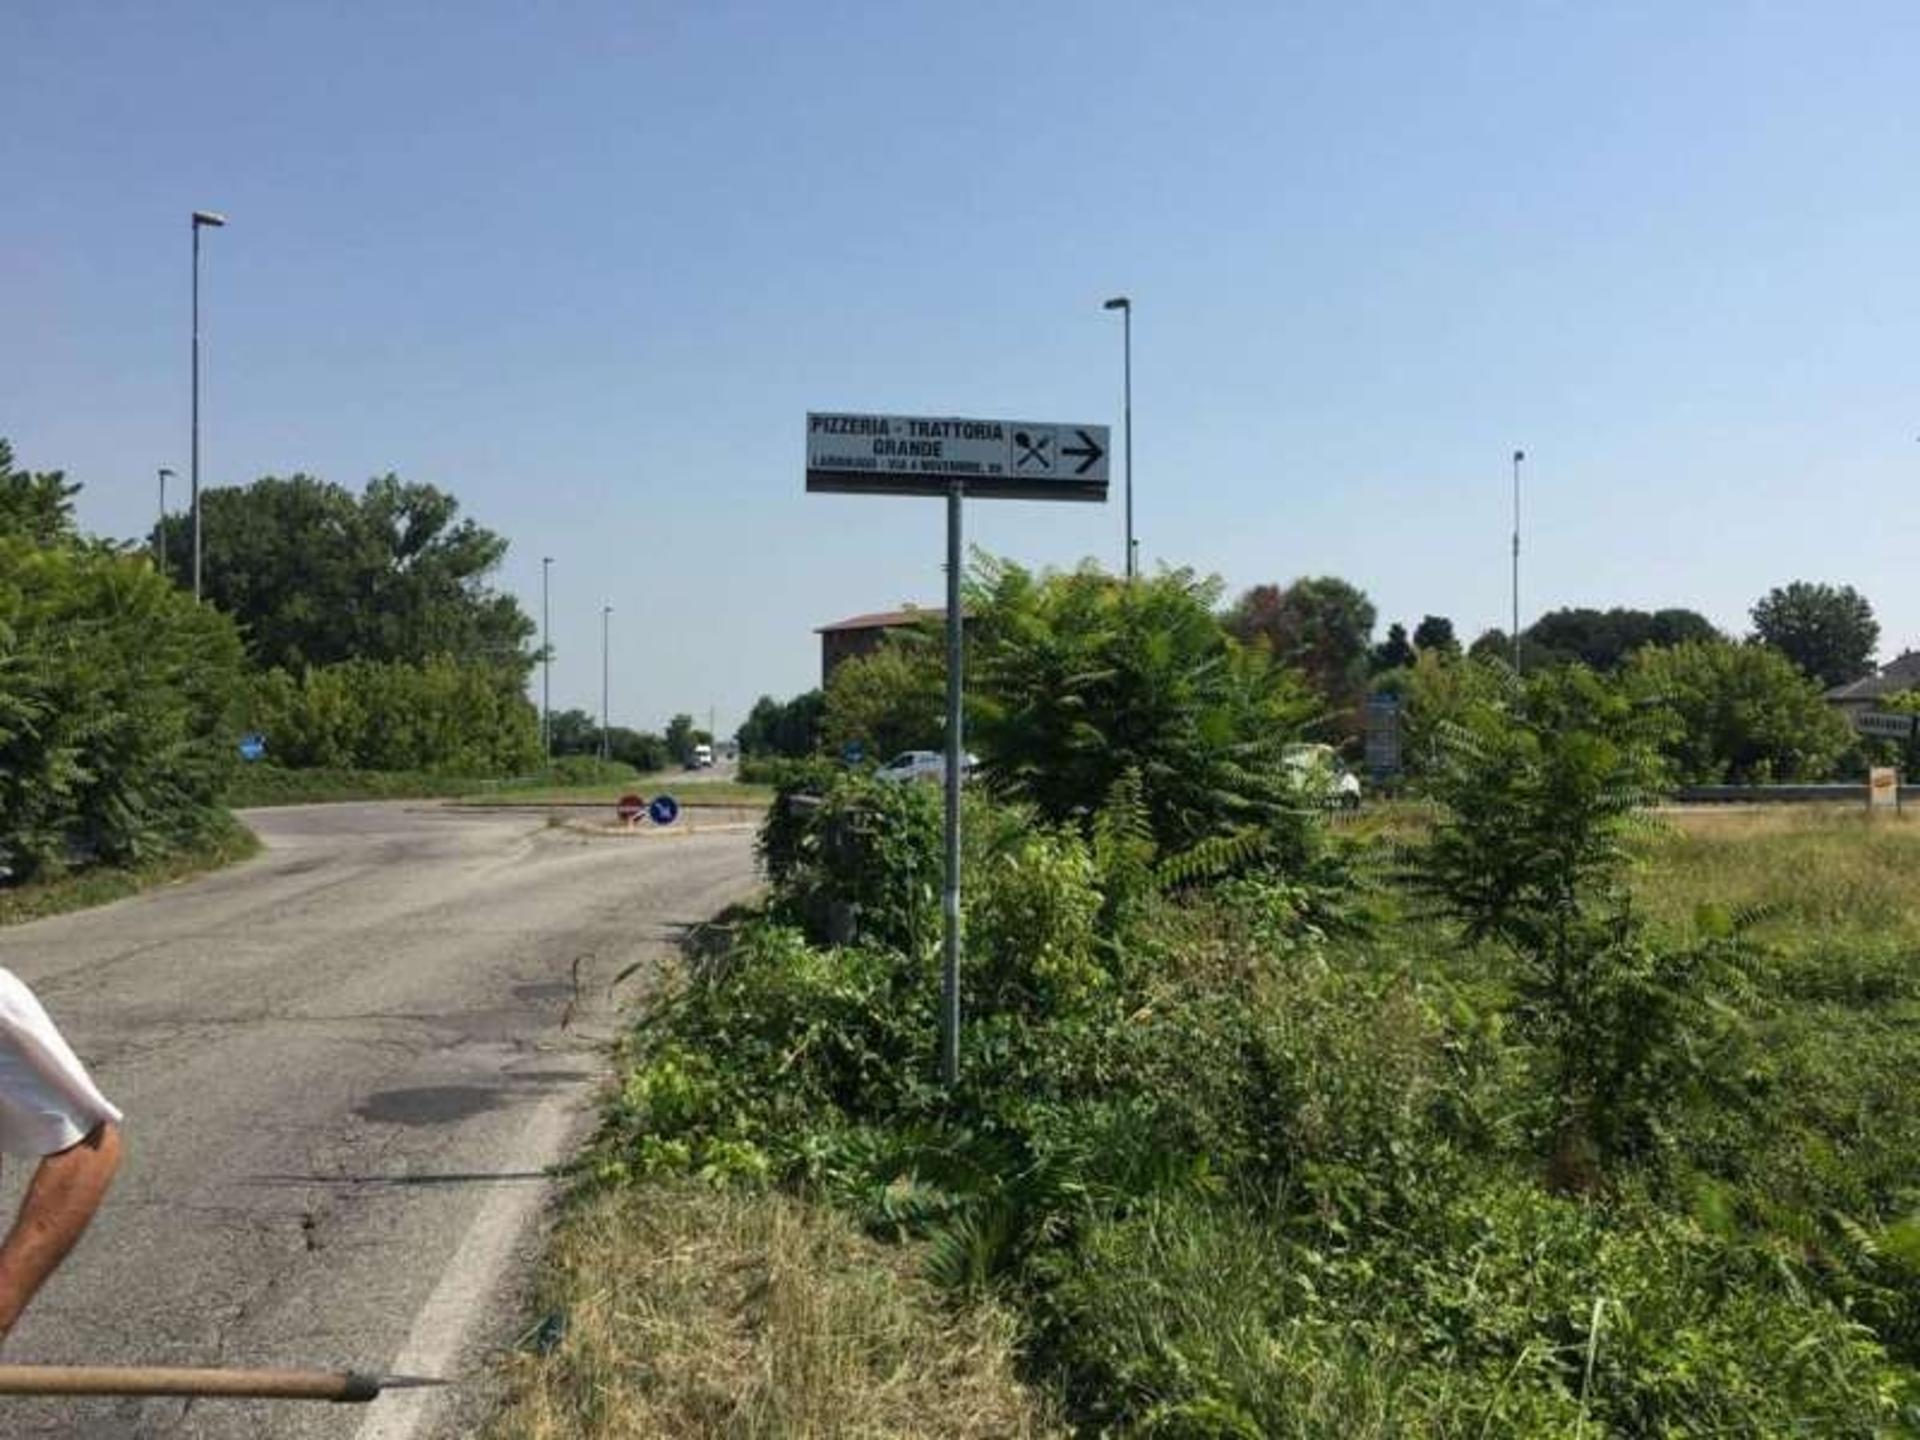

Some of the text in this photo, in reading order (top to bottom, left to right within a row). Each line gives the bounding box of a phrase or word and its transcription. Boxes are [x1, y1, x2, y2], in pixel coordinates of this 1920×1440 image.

[811, 417, 890, 435] PIZZERIA
[910, 421, 1004, 440] TRATTORIA
[873, 438, 943, 458] GRANDE
